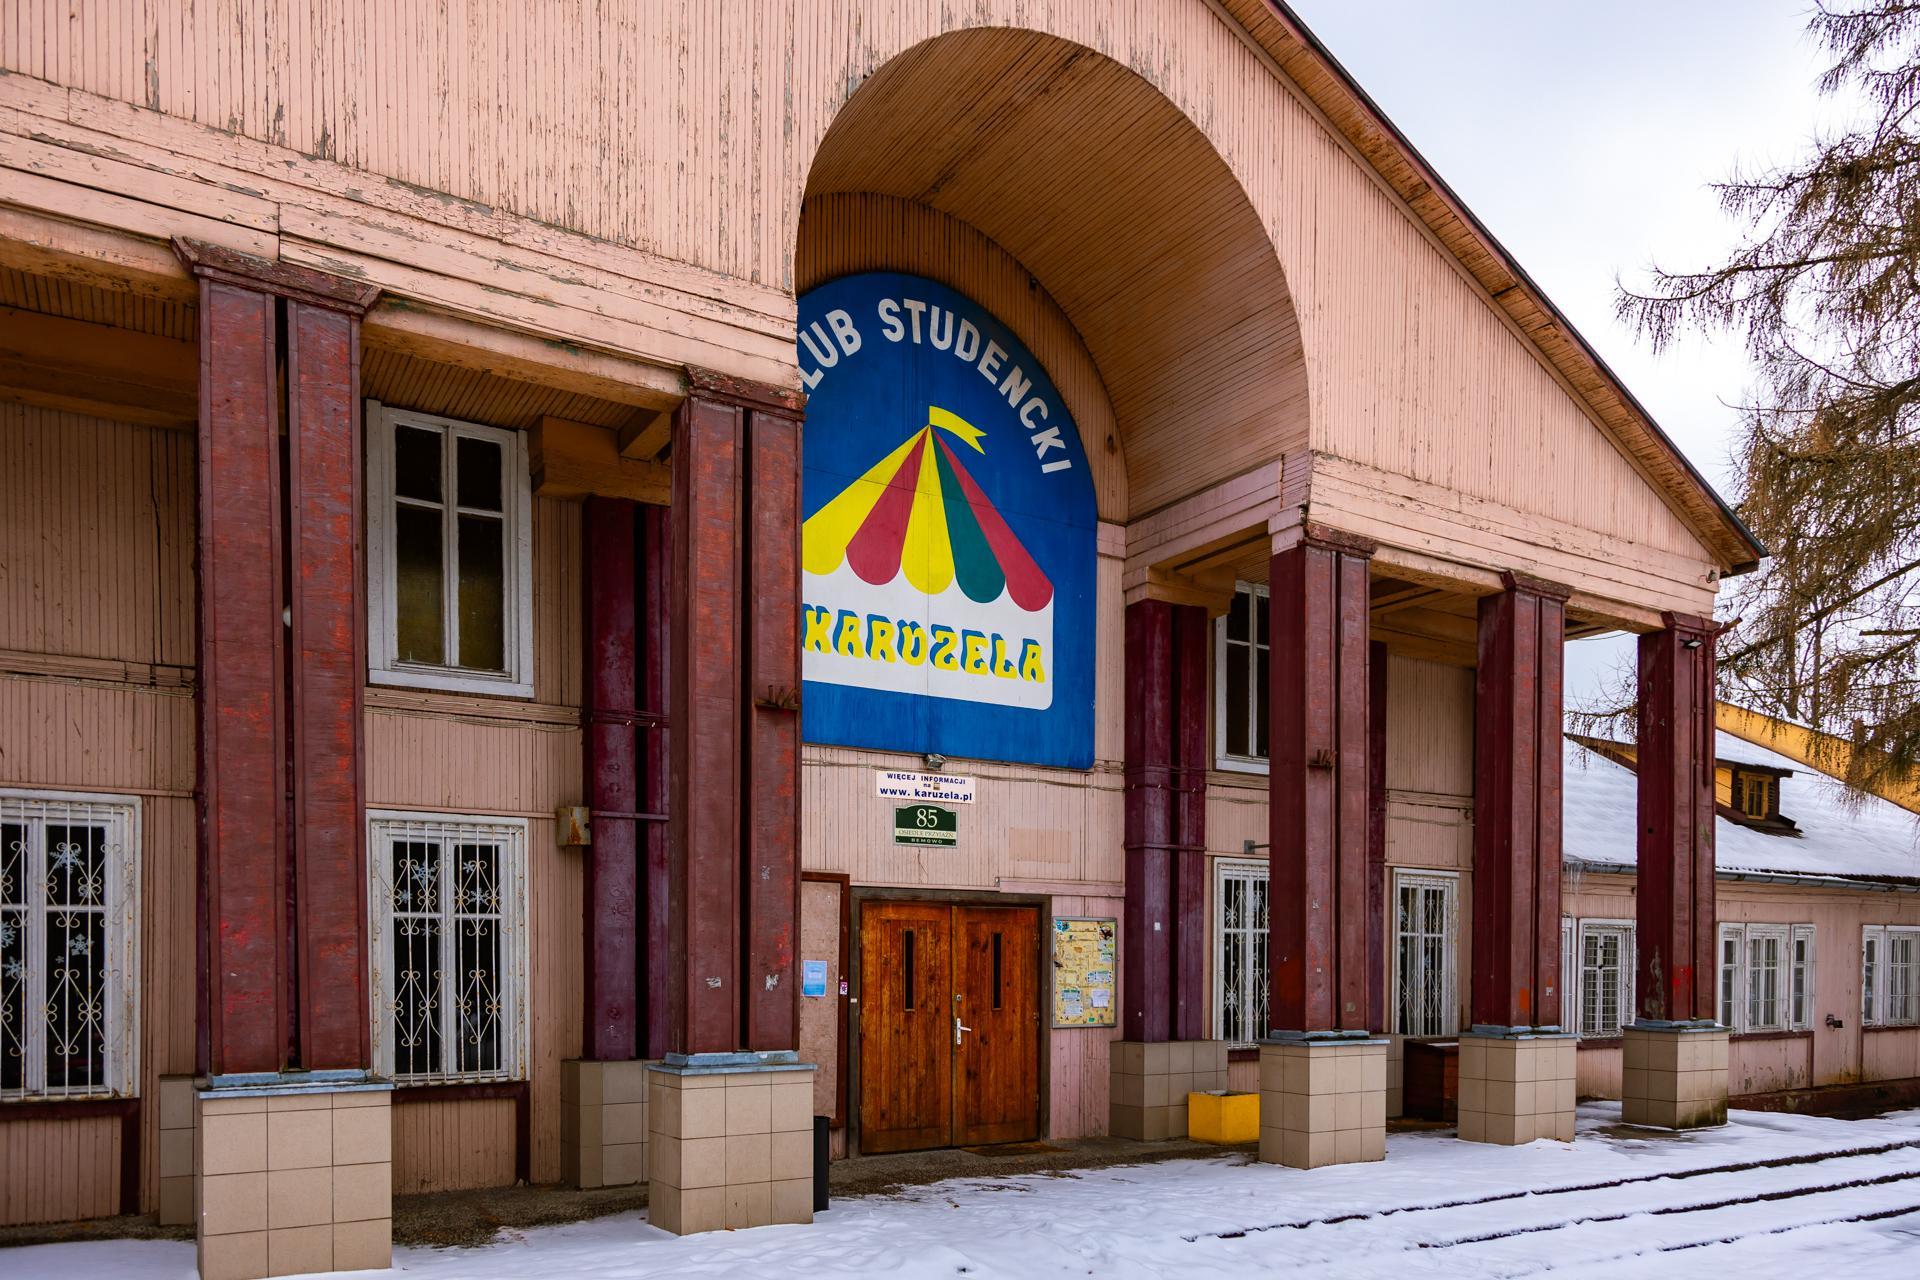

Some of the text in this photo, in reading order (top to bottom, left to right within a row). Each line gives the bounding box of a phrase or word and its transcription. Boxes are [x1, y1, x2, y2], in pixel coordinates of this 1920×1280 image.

[799, 298, 1073, 474] LUB STUDENCKI
[802, 603, 1046, 683] KARUZELA
[921, 776, 965, 784] INFORMACJI
[880, 788, 972, 801] www. karuzela.pl
[916, 808, 938, 828] 85
